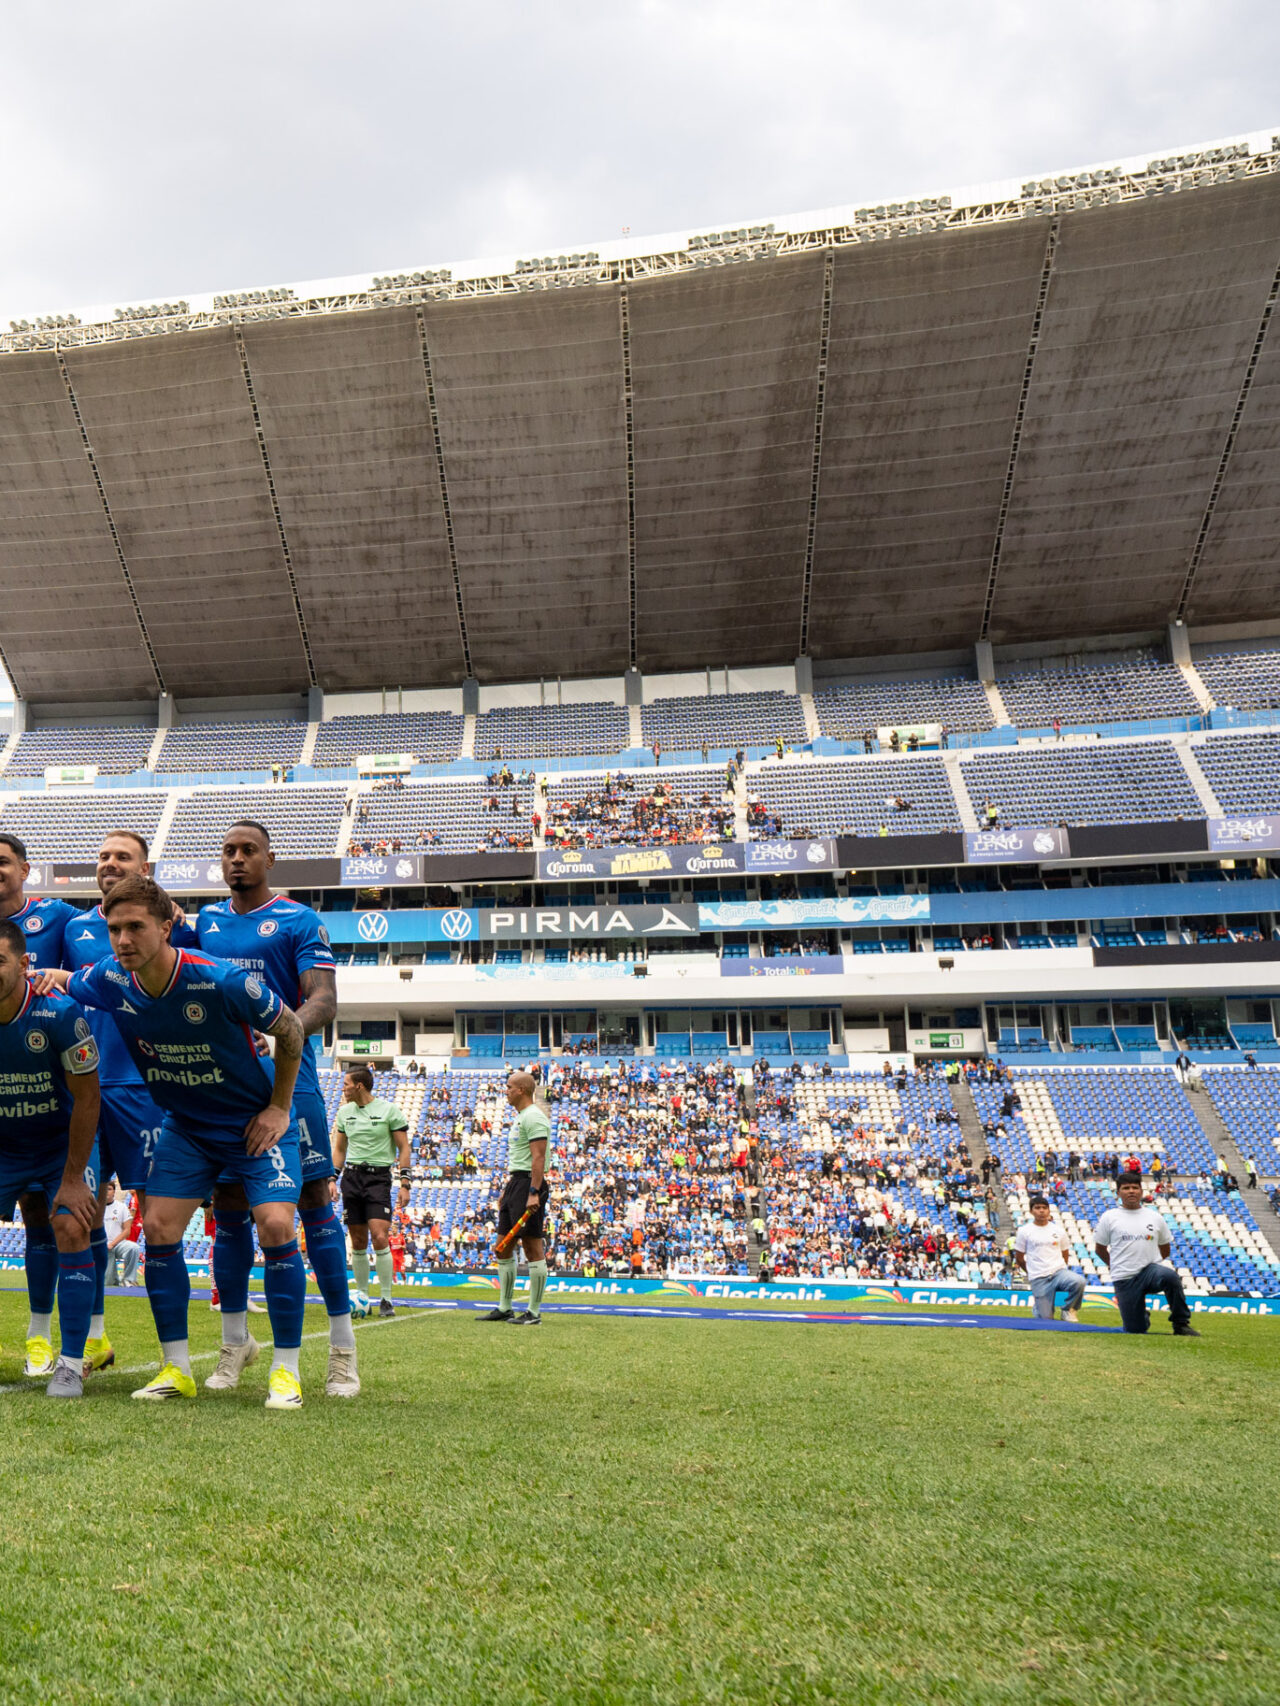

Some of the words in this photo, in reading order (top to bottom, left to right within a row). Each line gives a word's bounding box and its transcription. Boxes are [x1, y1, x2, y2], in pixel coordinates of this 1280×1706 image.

[546, 861, 597, 877] Corona
[686, 857, 738, 873] Corona
[490, 911, 634, 934] PIRMA
[187, 981, 216, 990] novibet
[153, 1043, 211, 1054] CEMENTO
[159, 1053, 187, 1065] CRUZ
[147, 1066, 225, 1086] novibet
[28, 1081, 54, 1093] AZUL
[267, 1144, 285, 1170] 8
[268, 1181, 296, 1189] PIRMA
[705, 1284, 827, 1301] Electrolit
